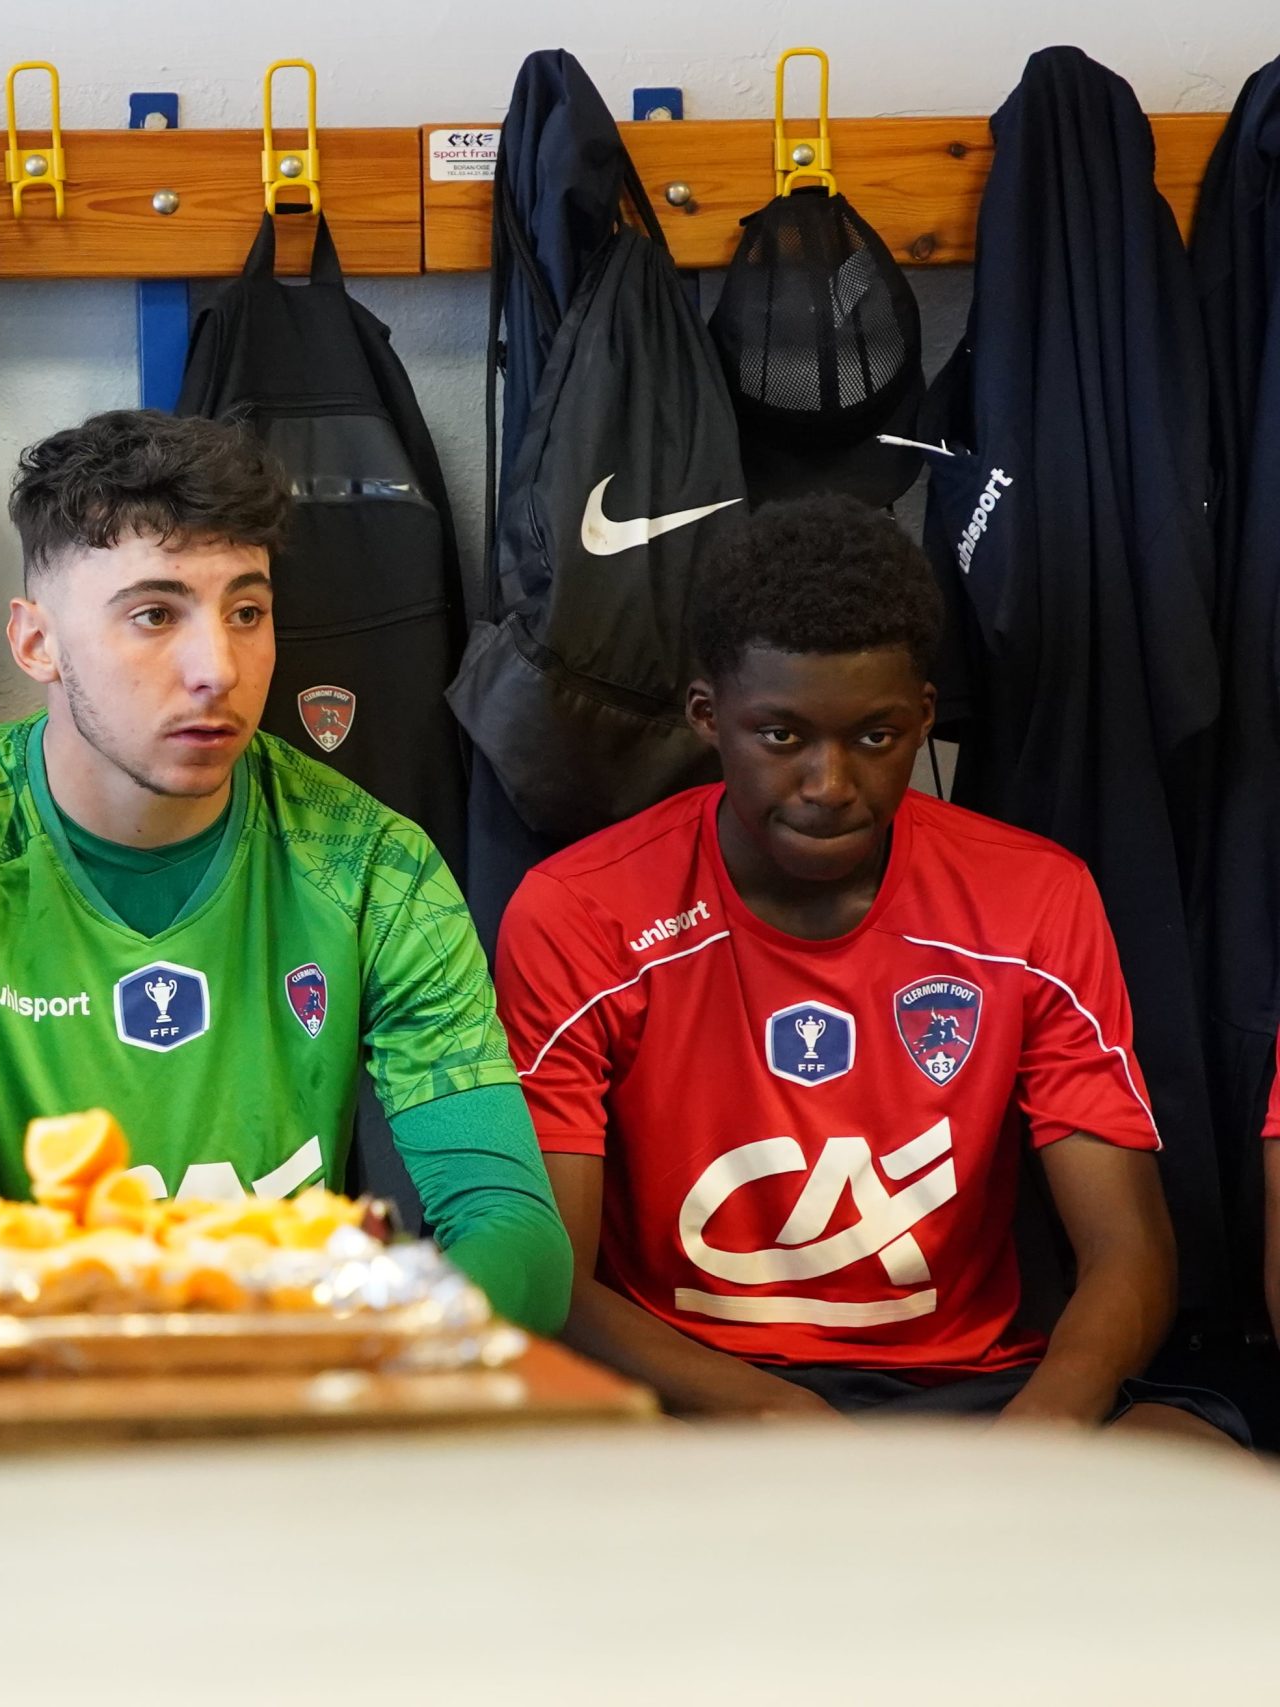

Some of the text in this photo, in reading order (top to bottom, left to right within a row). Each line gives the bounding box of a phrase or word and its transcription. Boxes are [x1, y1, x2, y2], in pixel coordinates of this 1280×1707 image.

[433, 149, 497, 159] sport fran
[957, 467, 1013, 574] uhlsport
[322, 736, 335, 744] 63
[902, 982, 975, 1005] CLERMONT FOOT
[150, 1026, 180, 1038] FFF
[797, 1063, 826, 1073] FFF
[931, 1061, 951, 1074] 63
